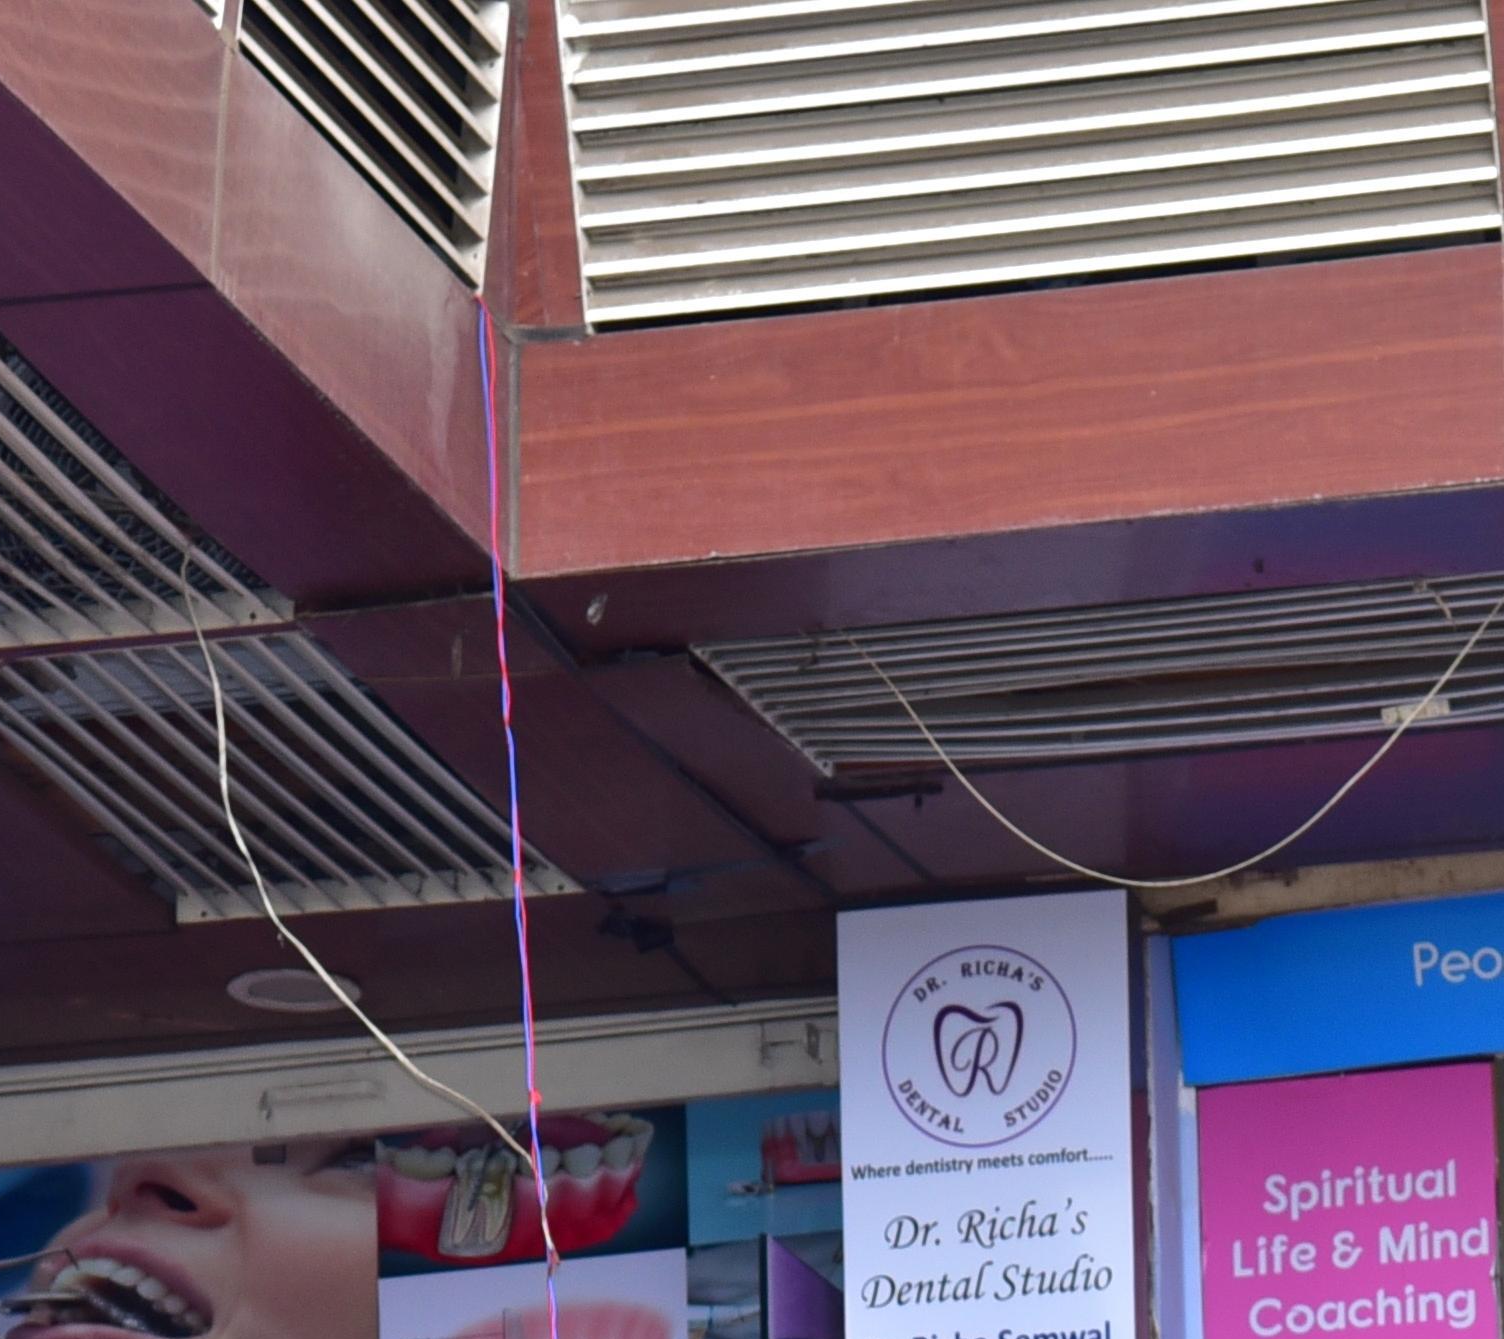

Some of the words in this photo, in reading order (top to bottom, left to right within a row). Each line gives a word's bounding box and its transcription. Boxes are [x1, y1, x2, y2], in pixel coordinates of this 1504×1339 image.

[1263, 1159, 1456, 1221] Spiritual
[885, 1215, 940, 1250] Dr.
[957, 1197, 1088, 1249] Richa's
[1233, 1234, 1316, 1278] Life
[1332, 1230, 1362, 1269] &
[1380, 1218, 1489, 1265] Mind
[861, 1260, 993, 1309] Dental
[995, 1254, 1113, 1303] Studio
[1249, 1284, 1476, 1337] Coaching
